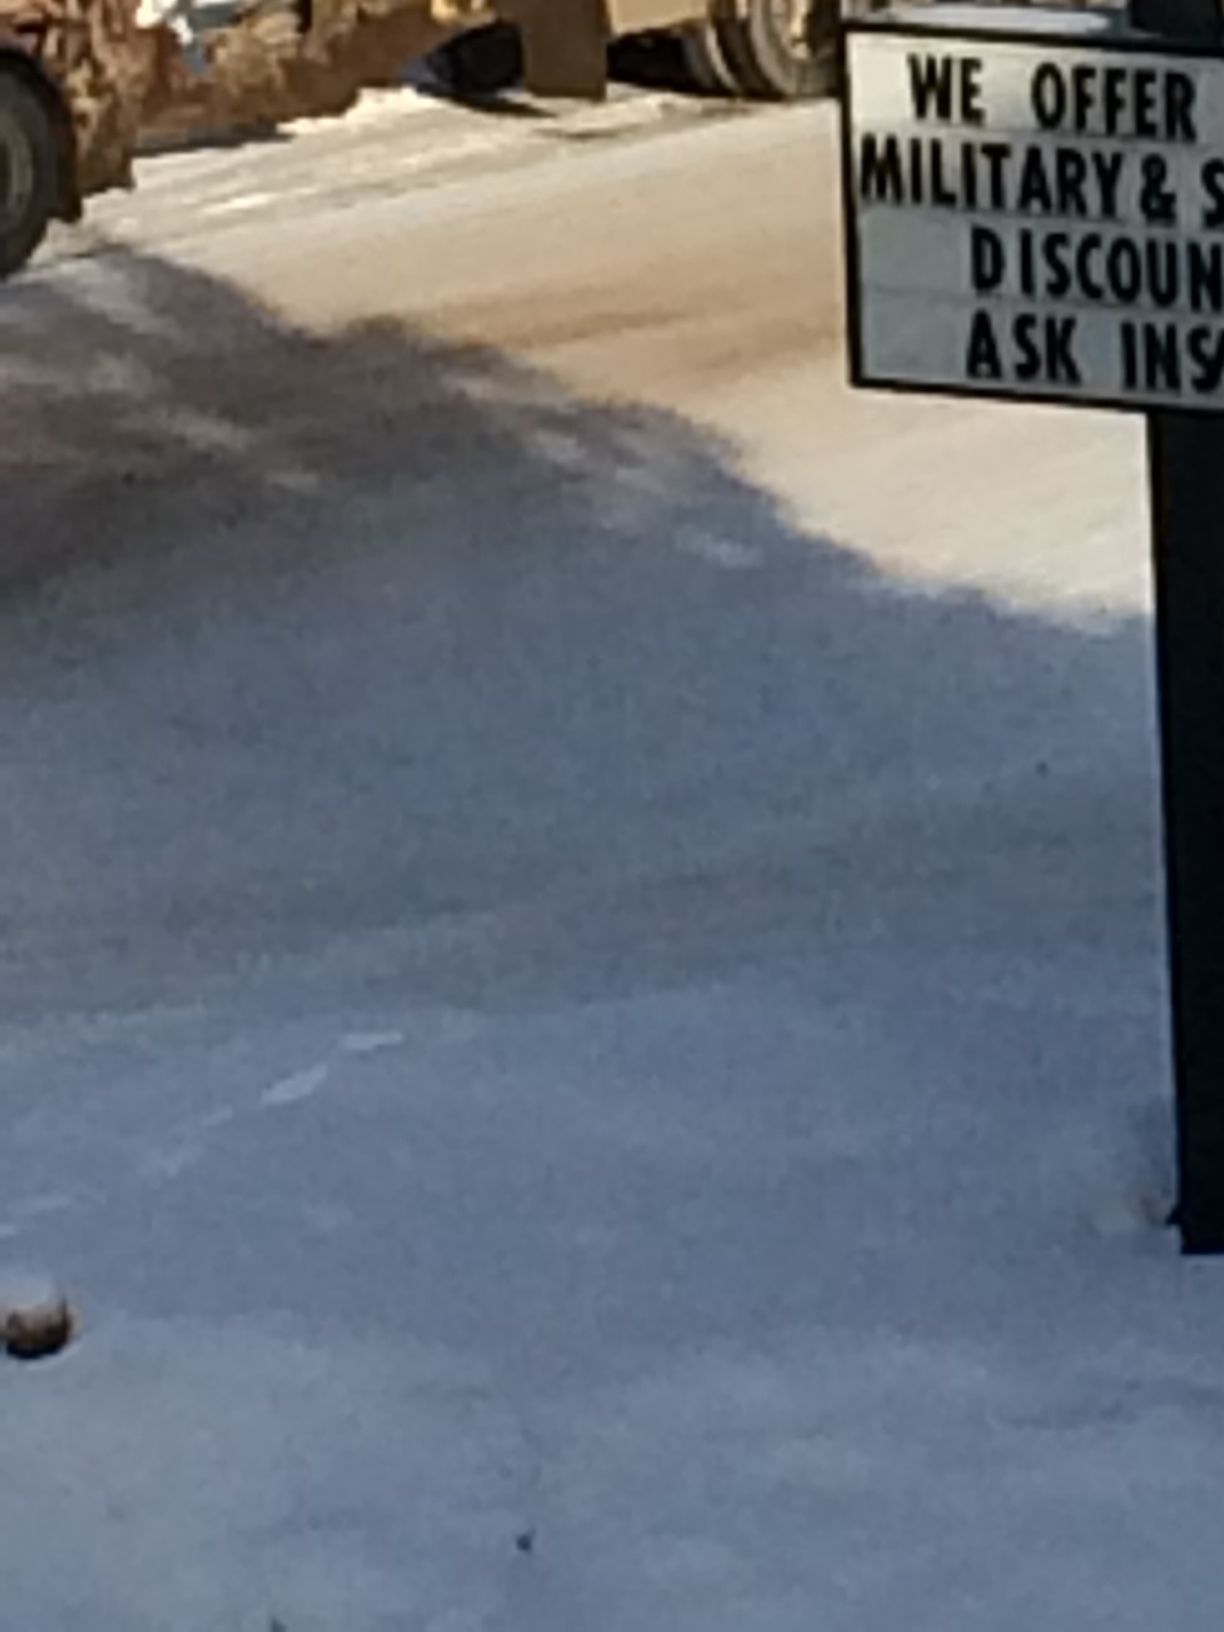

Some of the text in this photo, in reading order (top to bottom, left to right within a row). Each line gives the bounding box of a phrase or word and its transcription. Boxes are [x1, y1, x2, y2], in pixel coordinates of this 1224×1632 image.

[907, 53, 985, 125] WE
[1030, 62, 1197, 142] OFFER
[859, 133, 1124, 219] MILITARY
[1140, 153, 1177, 223] &
[966, 310, 1081, 384] ASK
